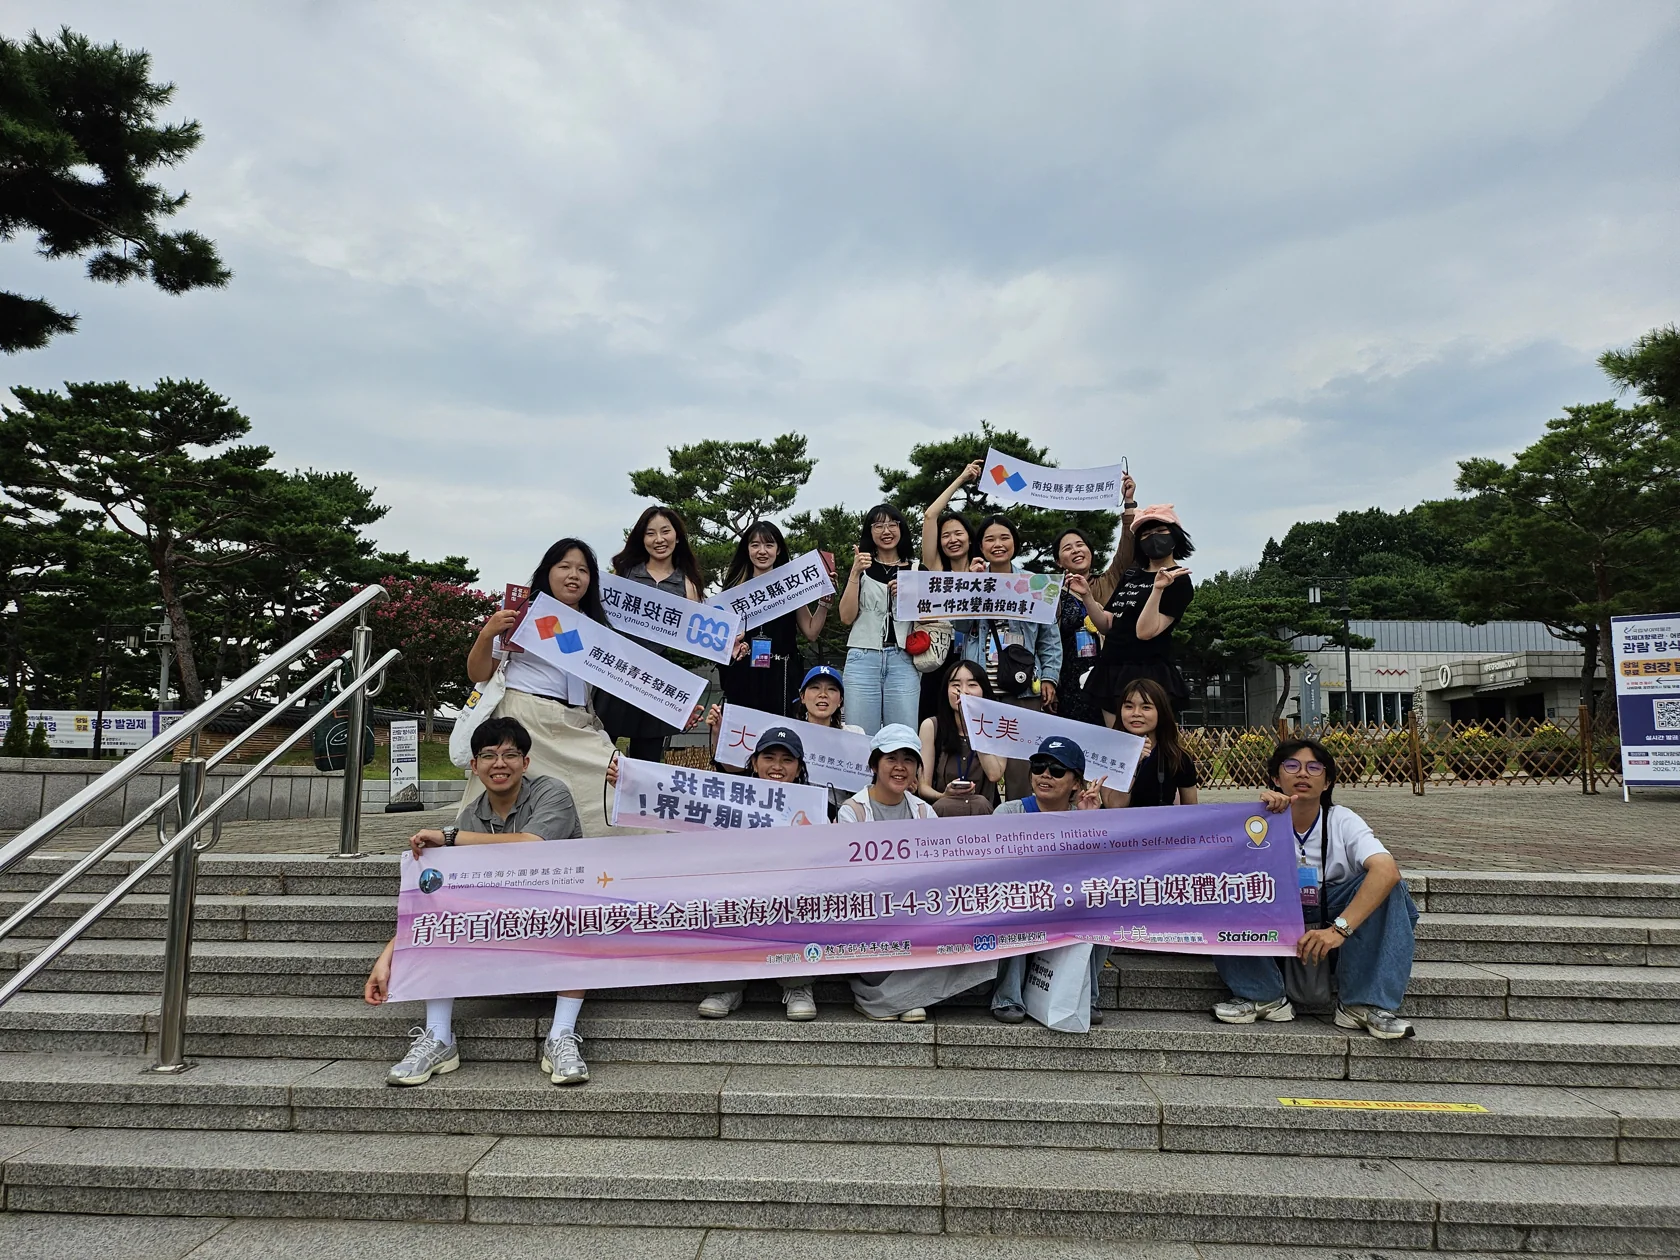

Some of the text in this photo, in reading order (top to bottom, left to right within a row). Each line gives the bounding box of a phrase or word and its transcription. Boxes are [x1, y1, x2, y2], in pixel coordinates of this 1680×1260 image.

[1032, 480, 1115, 494] 南投縣青年發展所
[730, 564, 820, 615] 南投縣政府
[928, 576, 997, 594] 我要和大家
[762, 598, 786, 611] County
[786, 579, 826, 601] Government
[1623, 642, 1650, 653] 관람
[588, 645, 690, 705] 南投縣青年發展所
[1642, 661, 1671, 673] 현장
[584, 659, 683, 713] Nantou Youth Development Office
[115, 718, 147, 730] 발권제
[804, 753, 872, 774] 美國際文化創意
[915, 828, 1108, 847] Taiwan Global Pathfinders Initiative
[942, 846, 992, 859] Pathways
[994, 844, 1005, 854] of
[1007, 843, 1035, 855] Light
[1037, 842, 1057, 853] and
[1059, 841, 1101, 851] Shadow
[1109, 838, 1139, 849] Youth
[1142, 836, 1196, 848] Self-Media
[1198, 833, 1233, 844] Action
[848, 838, 911, 862] 2026
[447, 876, 585, 890] Taiwan Global Pathfinders Initiative
[998, 931, 1047, 944] 南投縣政府
[1217, 930, 1279, 943] StationR
